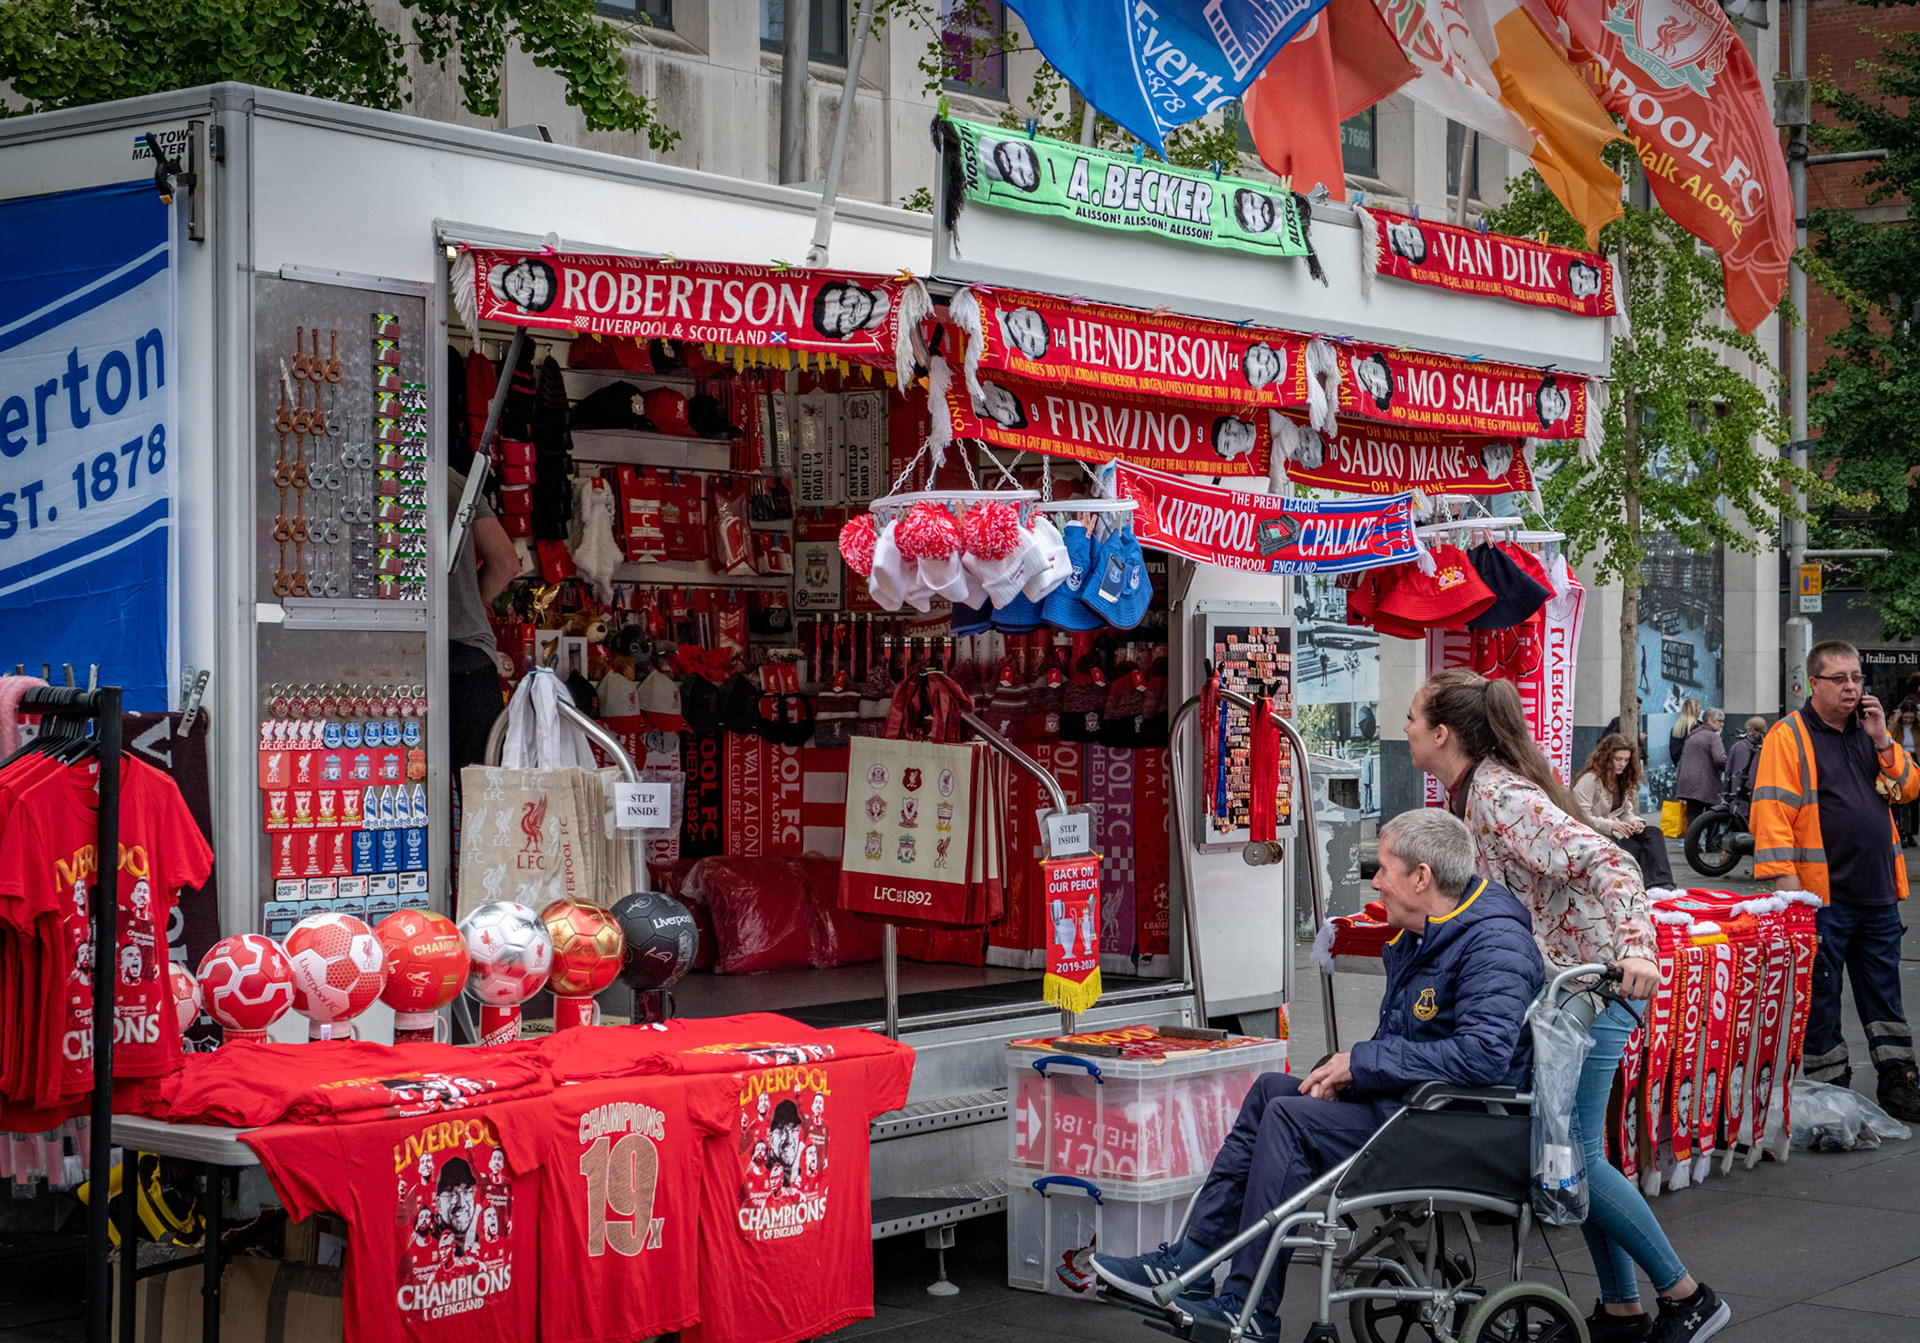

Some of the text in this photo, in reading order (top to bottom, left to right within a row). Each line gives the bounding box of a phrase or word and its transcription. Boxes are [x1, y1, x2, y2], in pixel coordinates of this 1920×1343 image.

[132, 142, 187, 160] MATER
[159, 129, 189, 144] TOW
[1067, 157, 1213, 226] A.BECKER
[1721, 156, 1763, 217] FC
[1680, 174, 1743, 239] Alone
[1075, 207, 1213, 241] ALISSON! ALISSON! ALISSON!
[1439, 231, 1494, 277] VAN
[1500, 243, 1556, 289] DIJK
[562, 267, 810, 329] ROBERTSON
[591, 317, 767, 344] LIVERPOOL & SCOTLAND
[1053, 317, 1239, 381] 14 HENDERSON 14
[1074, 368, 1099, 383] JORDAN
[1163, 381, 1182, 394] LOVES
[1182, 383, 1196, 396] YOU
[1407, 367, 1446, 409] MO
[1452, 373, 1525, 418] SALAH
[1031, 395, 1204, 454] 9 FIRMINO 9
[1366, 425, 1380, 438] OH
[1392, 406, 1407, 419] MO
[1407, 409, 1431, 424] SALAH
[1431, 412, 1446, 425] MO
[1473, 416, 1486, 429] THE
[71, 424, 167, 510] 1878
[849, 444, 858, 498] ANFIELD
[860, 446, 870, 497] ROAD L4
[1329, 436, 1478, 481] 10 SADIO MANÉ 10
[802, 453, 812, 501] ANFIELD
[813, 451, 823, 501] ROAD L4
[1371, 480, 1389, 492] OH
[1231, 491, 1319, 513] THE PREM LEAGUE
[1157, 494, 1256, 552] LIVERPOOL
[1211, 552, 1317, 574] LIVERPOOL ENGLAND
[1866, 653, 1918, 664] Italian Deli
[731, 764, 741, 795] CLUB
[744, 748, 759, 797] WALK
[627, 806, 660, 816] INSIDE
[631, 794, 655, 804] STEP
[363, 818, 379, 829] 1878
[379, 817, 395, 828] 1878
[395, 817, 412, 828] 1878
[412, 816, 428, 826] 1878
[559, 816, 569, 836] FC
[701, 806, 717, 842] FC
[771, 791, 780, 844] ALONE
[781, 808, 800, 844] FC
[1059, 824, 1078, 834] STEP
[731, 830, 741, 856] 1892
[1058, 835, 1081, 846] INSIDE
[1048, 878, 1098, 894] OUR PERCH
[1053, 866, 1094, 881] BACK ON
[874, 886, 932, 906] LFC 1892
[1056, 958, 1096, 974] 2019-2020
[299, 957, 340, 1013] Liverpool FC
[1653, 957, 1675, 1052] DIJK
[1738, 1041, 1745, 1054] 10
[739, 1066, 832, 1107] LIVERPOOL
[579, 1102, 665, 1145] CHAMPIONS
[738, 1197, 827, 1231] CHAMPIONS
[763, 1225, 804, 1240] OF ENGLAND
[397, 1264, 511, 1311] CHAMPIONS
[432, 1297, 484, 1319] OF ENGLAND
